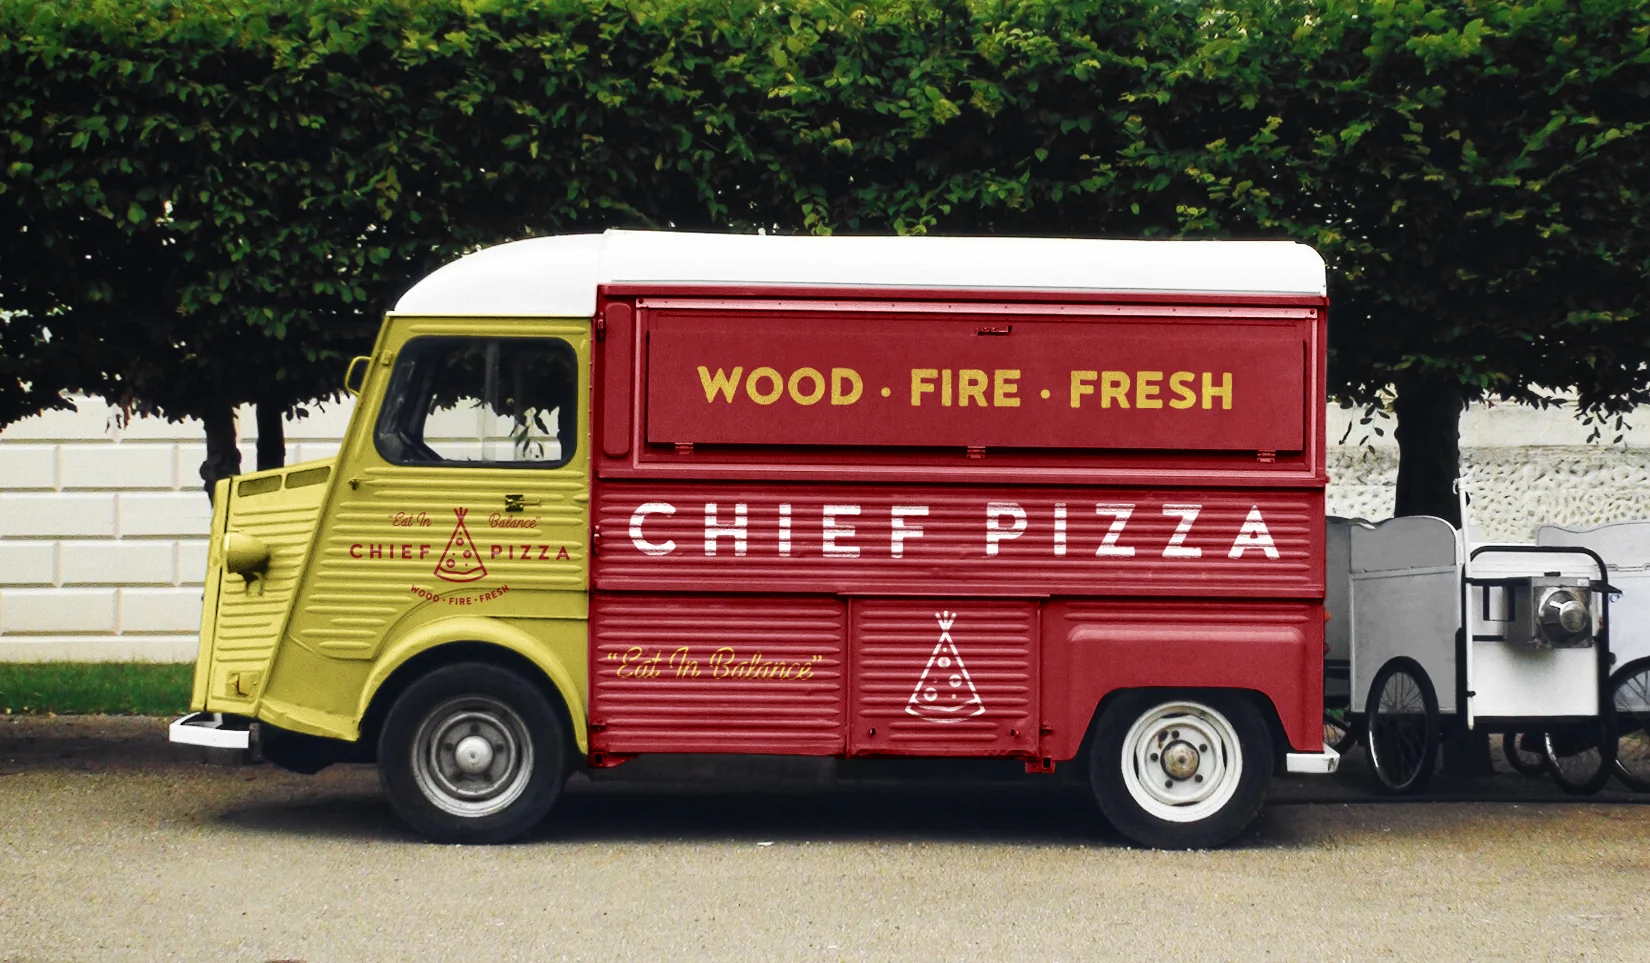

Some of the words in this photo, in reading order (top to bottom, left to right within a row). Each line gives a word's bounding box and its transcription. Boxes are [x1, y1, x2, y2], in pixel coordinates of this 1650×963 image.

[698, 366, 863, 405] WOOD
[911, 369, 1021, 407] FIRE
[1070, 370, 1233, 410] FRESH
[415, 512, 432, 527] In
[628, 502, 930, 559] CHIEF
[985, 502, 1280, 559] PIZZA
[349, 543, 431, 560] CHIEF
[490, 544, 571, 561] PIZZA
[410, 584, 440, 603] WOOD
[448, 597, 472, 606] FIRE
[479, 584, 510, 603] FRESH
[669, 646, 701, 680] In
